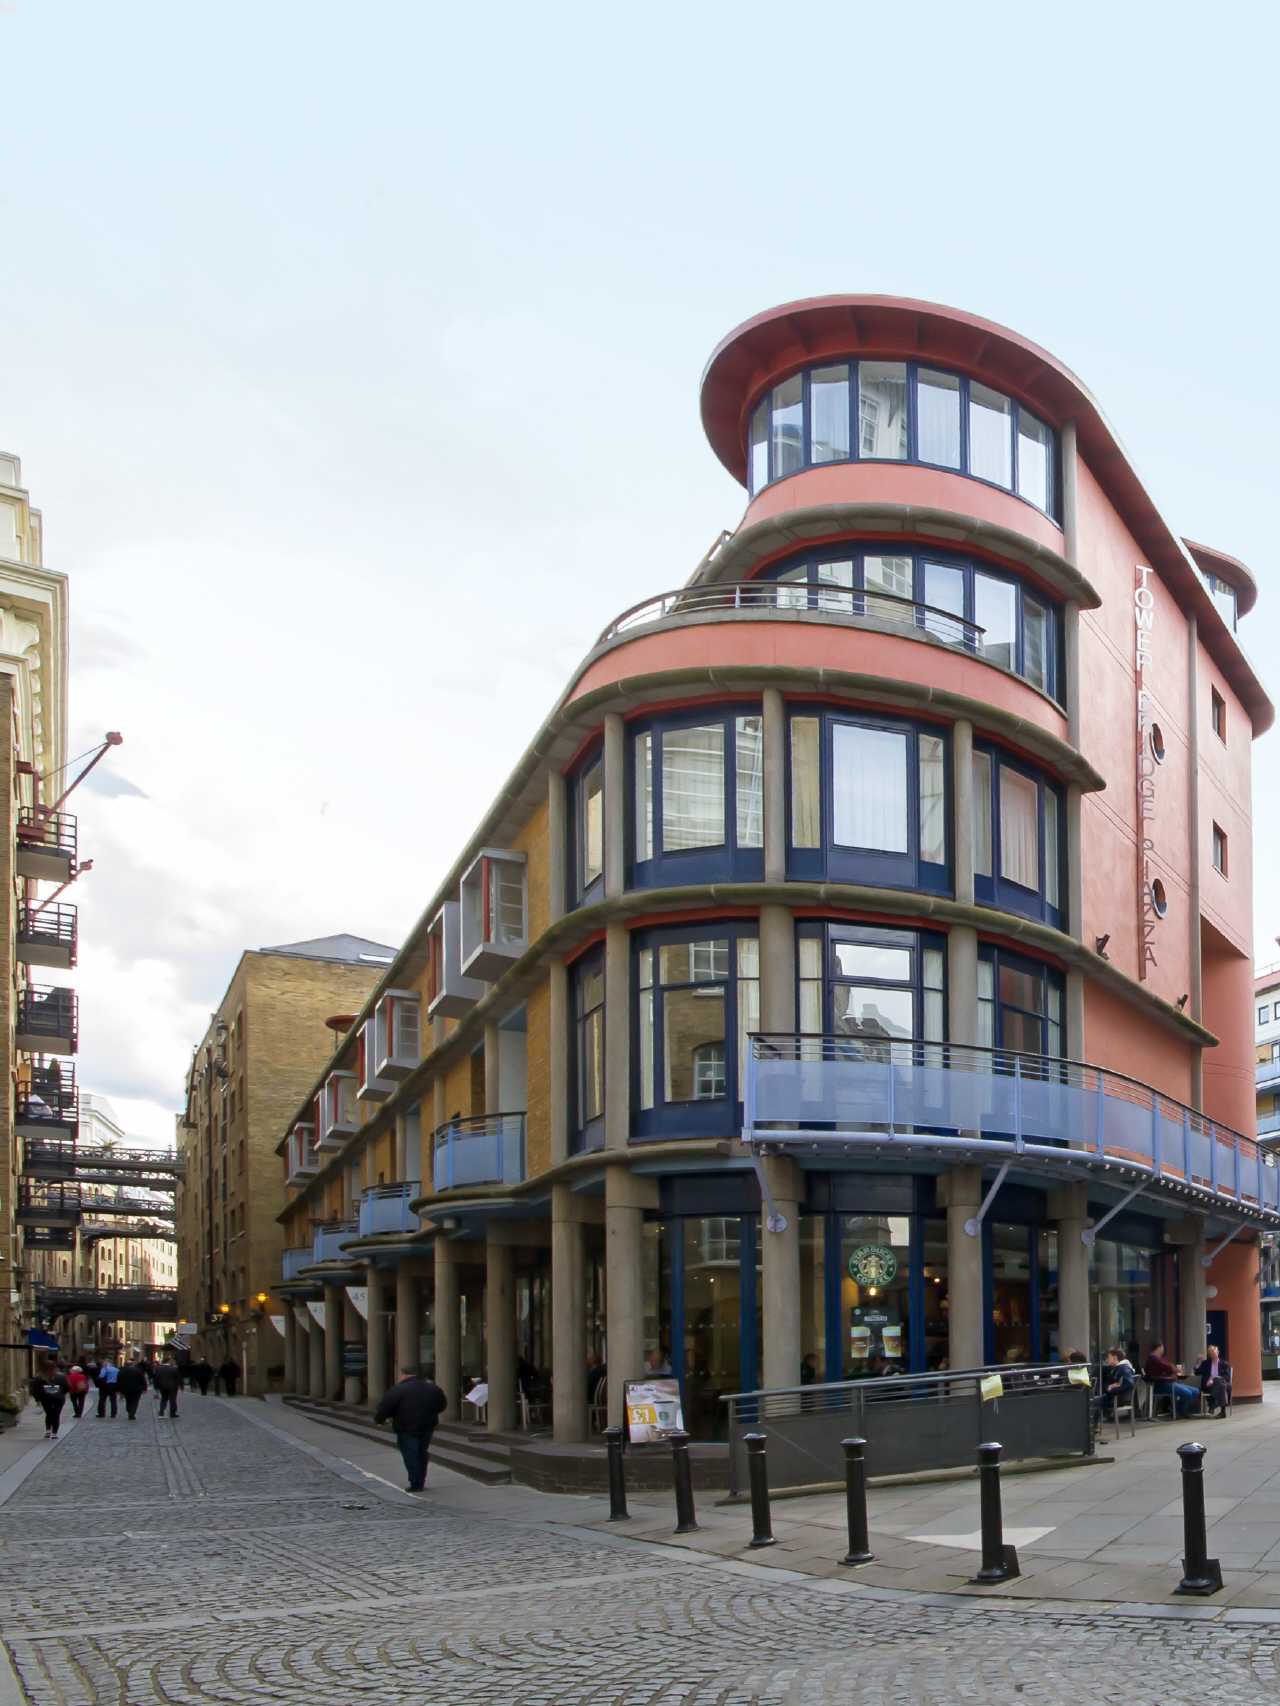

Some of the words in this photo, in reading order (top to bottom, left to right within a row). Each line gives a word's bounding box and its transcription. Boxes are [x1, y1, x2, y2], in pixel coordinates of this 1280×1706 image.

[1135, 564, 1154, 673] TOWER
[852, 1247, 894, 1265] STARBUCKS
[857, 1274, 890, 1285] COFFEE
